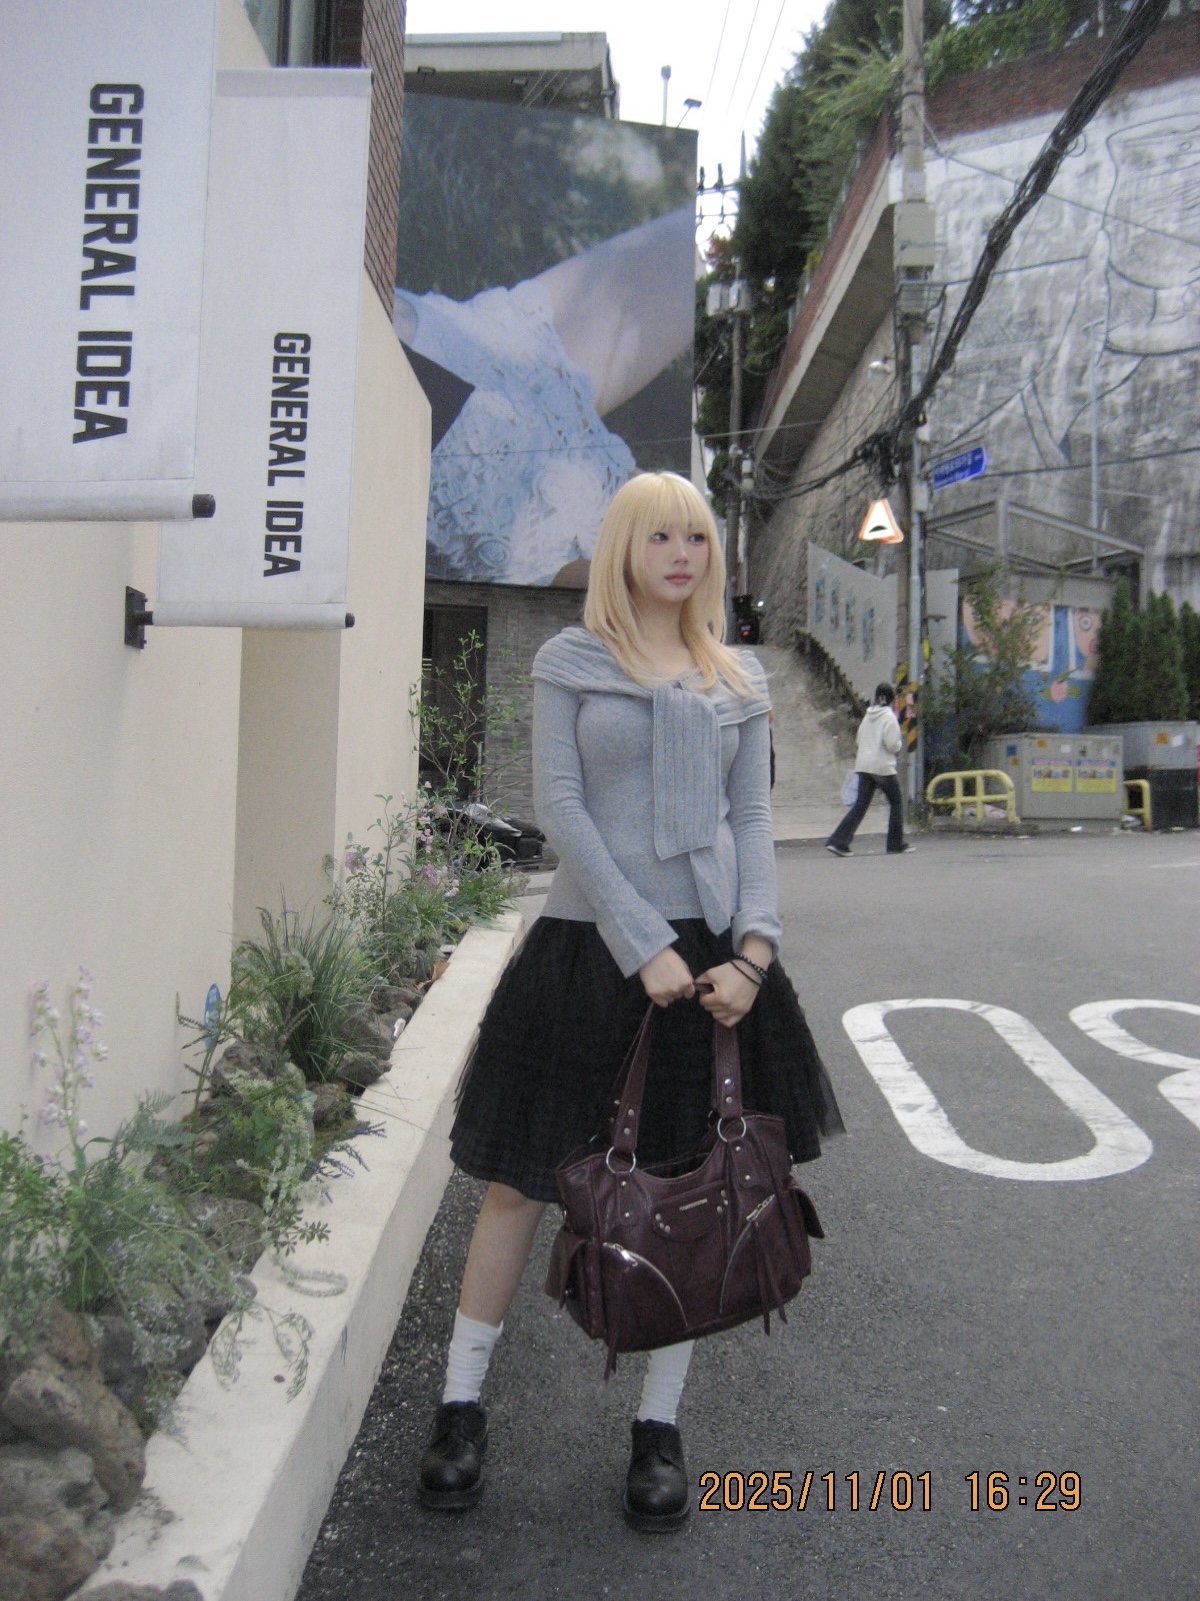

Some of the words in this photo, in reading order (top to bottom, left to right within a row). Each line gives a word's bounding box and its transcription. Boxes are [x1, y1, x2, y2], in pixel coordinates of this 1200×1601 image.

[80, 83, 145, 311] GENERAL
[72, 330, 133, 444] IDEA
[267, 332, 312, 487] GENERAL
[263, 500, 304, 577] IDEA
